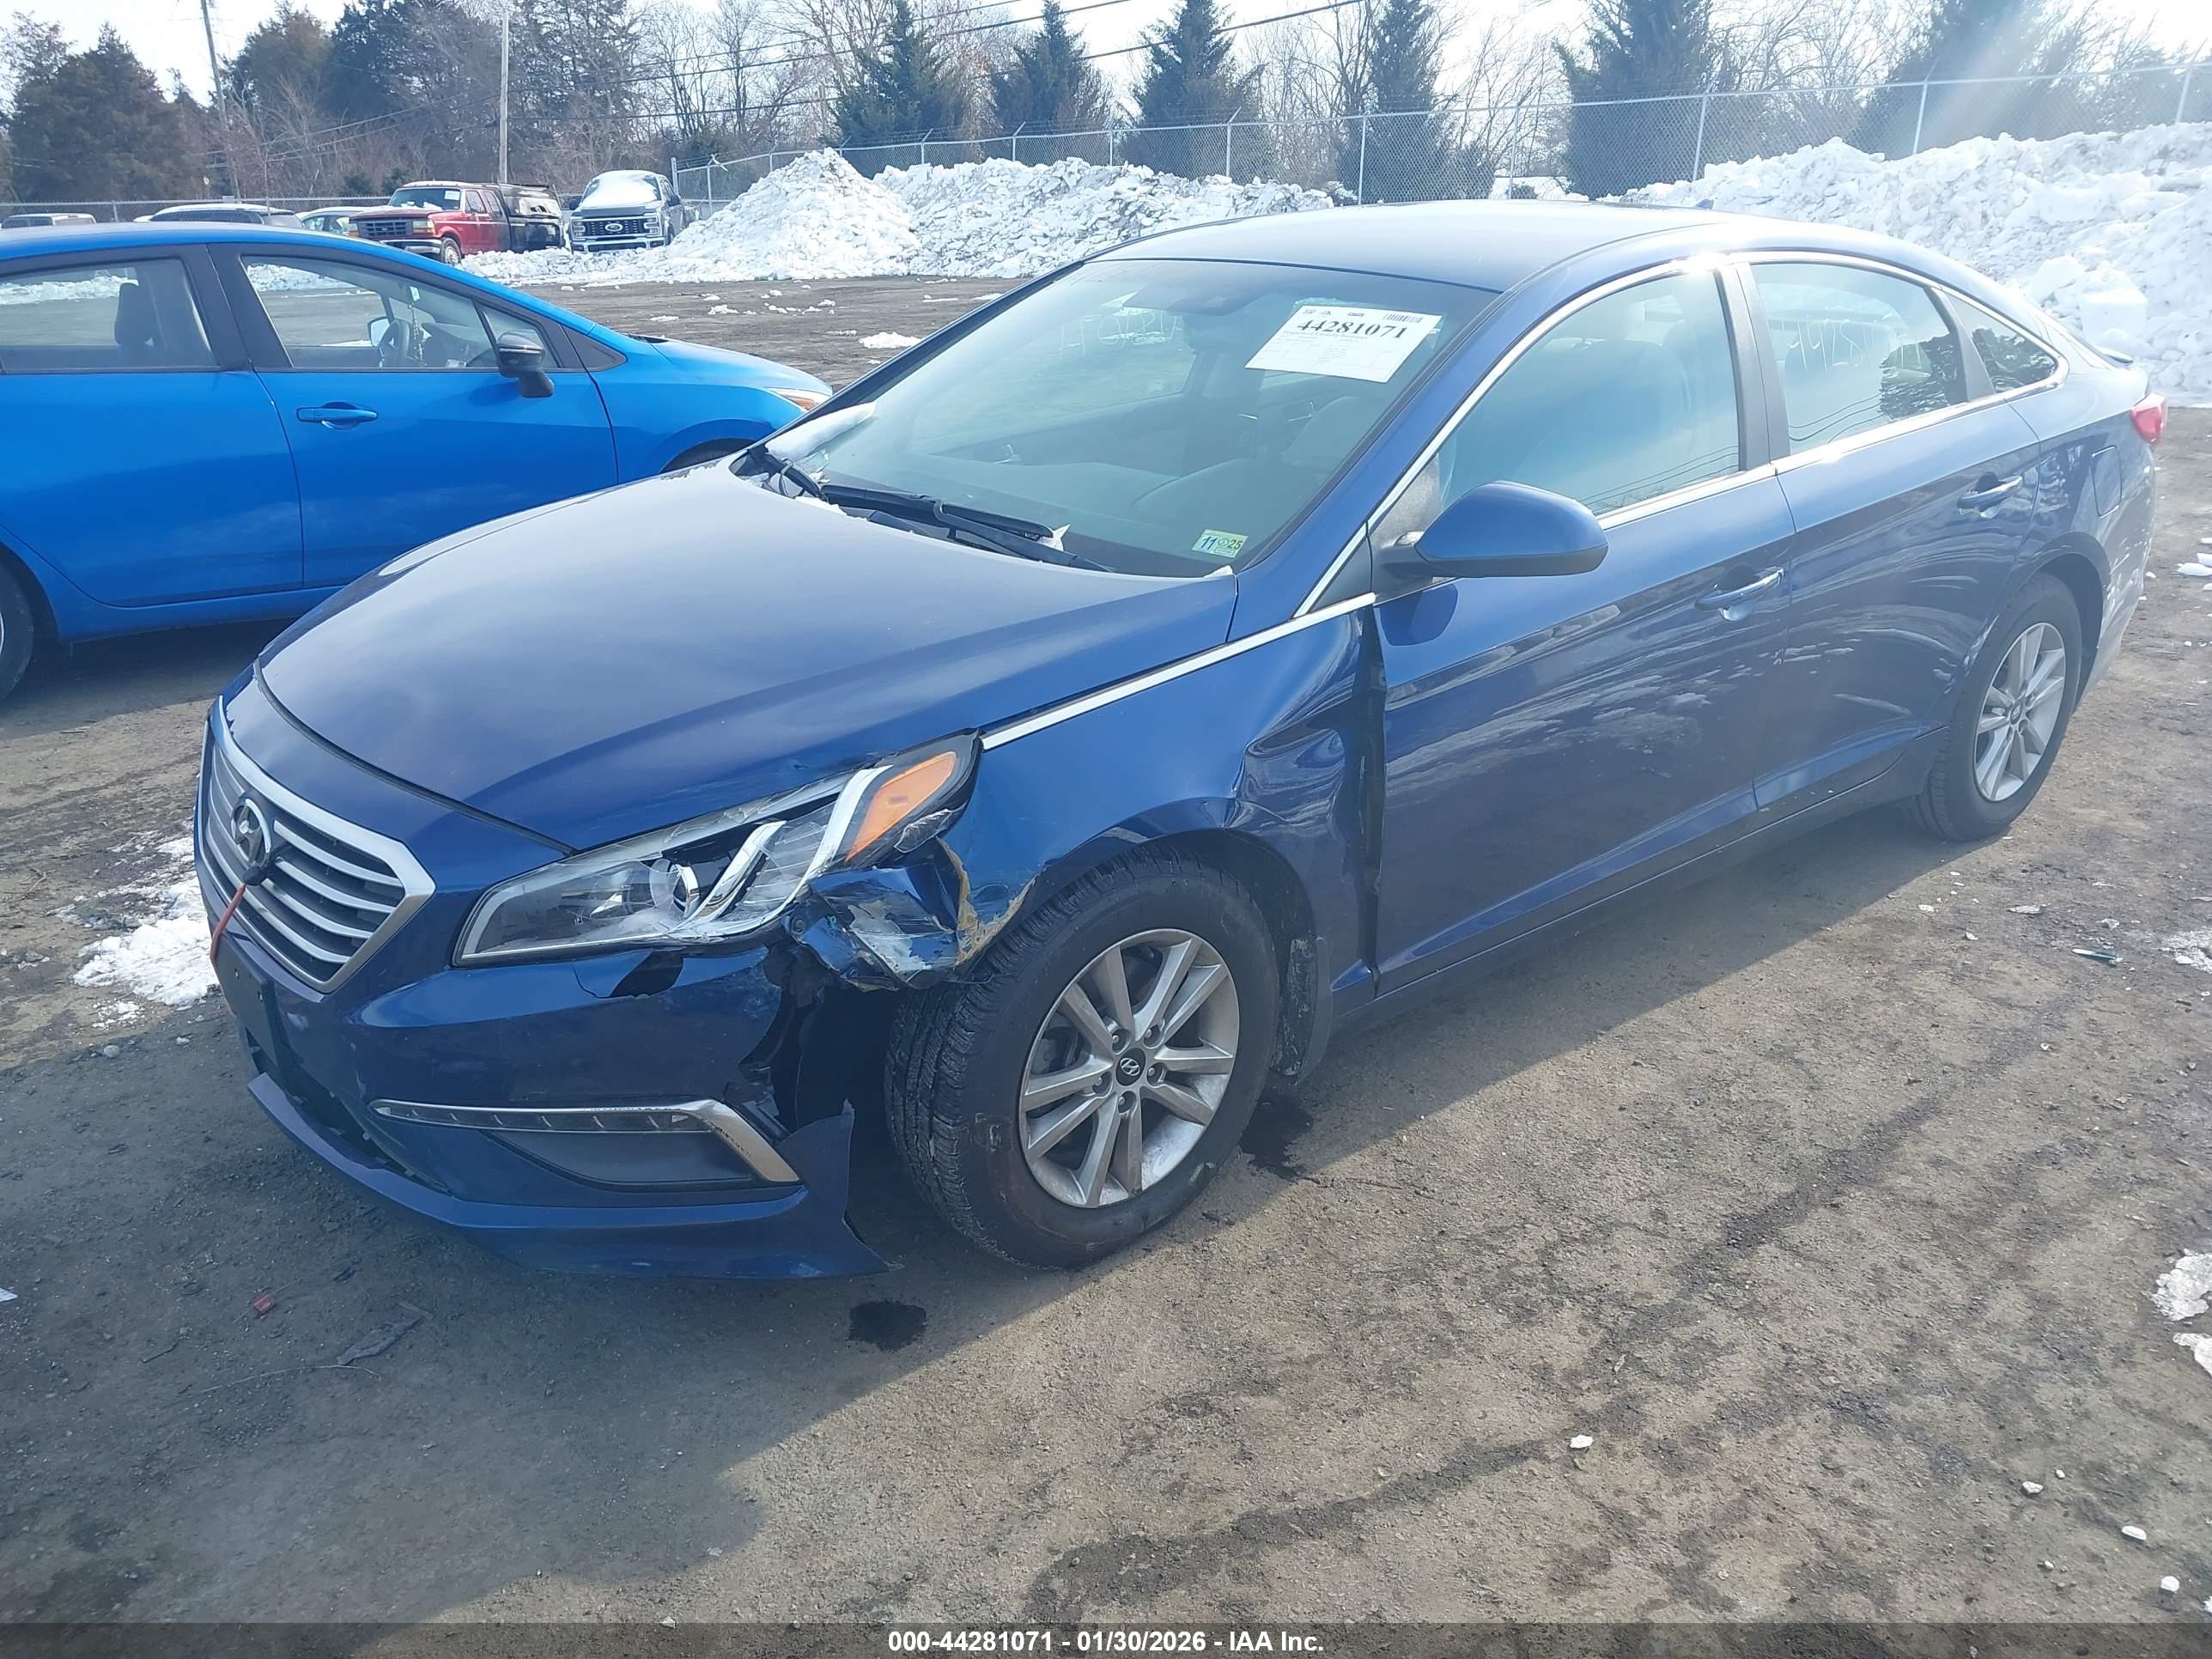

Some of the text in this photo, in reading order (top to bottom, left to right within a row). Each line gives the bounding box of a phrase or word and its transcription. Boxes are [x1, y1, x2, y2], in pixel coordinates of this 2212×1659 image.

[1297, 319, 1407, 338] 44281071
[1201, 537, 1243, 550] 11 25
